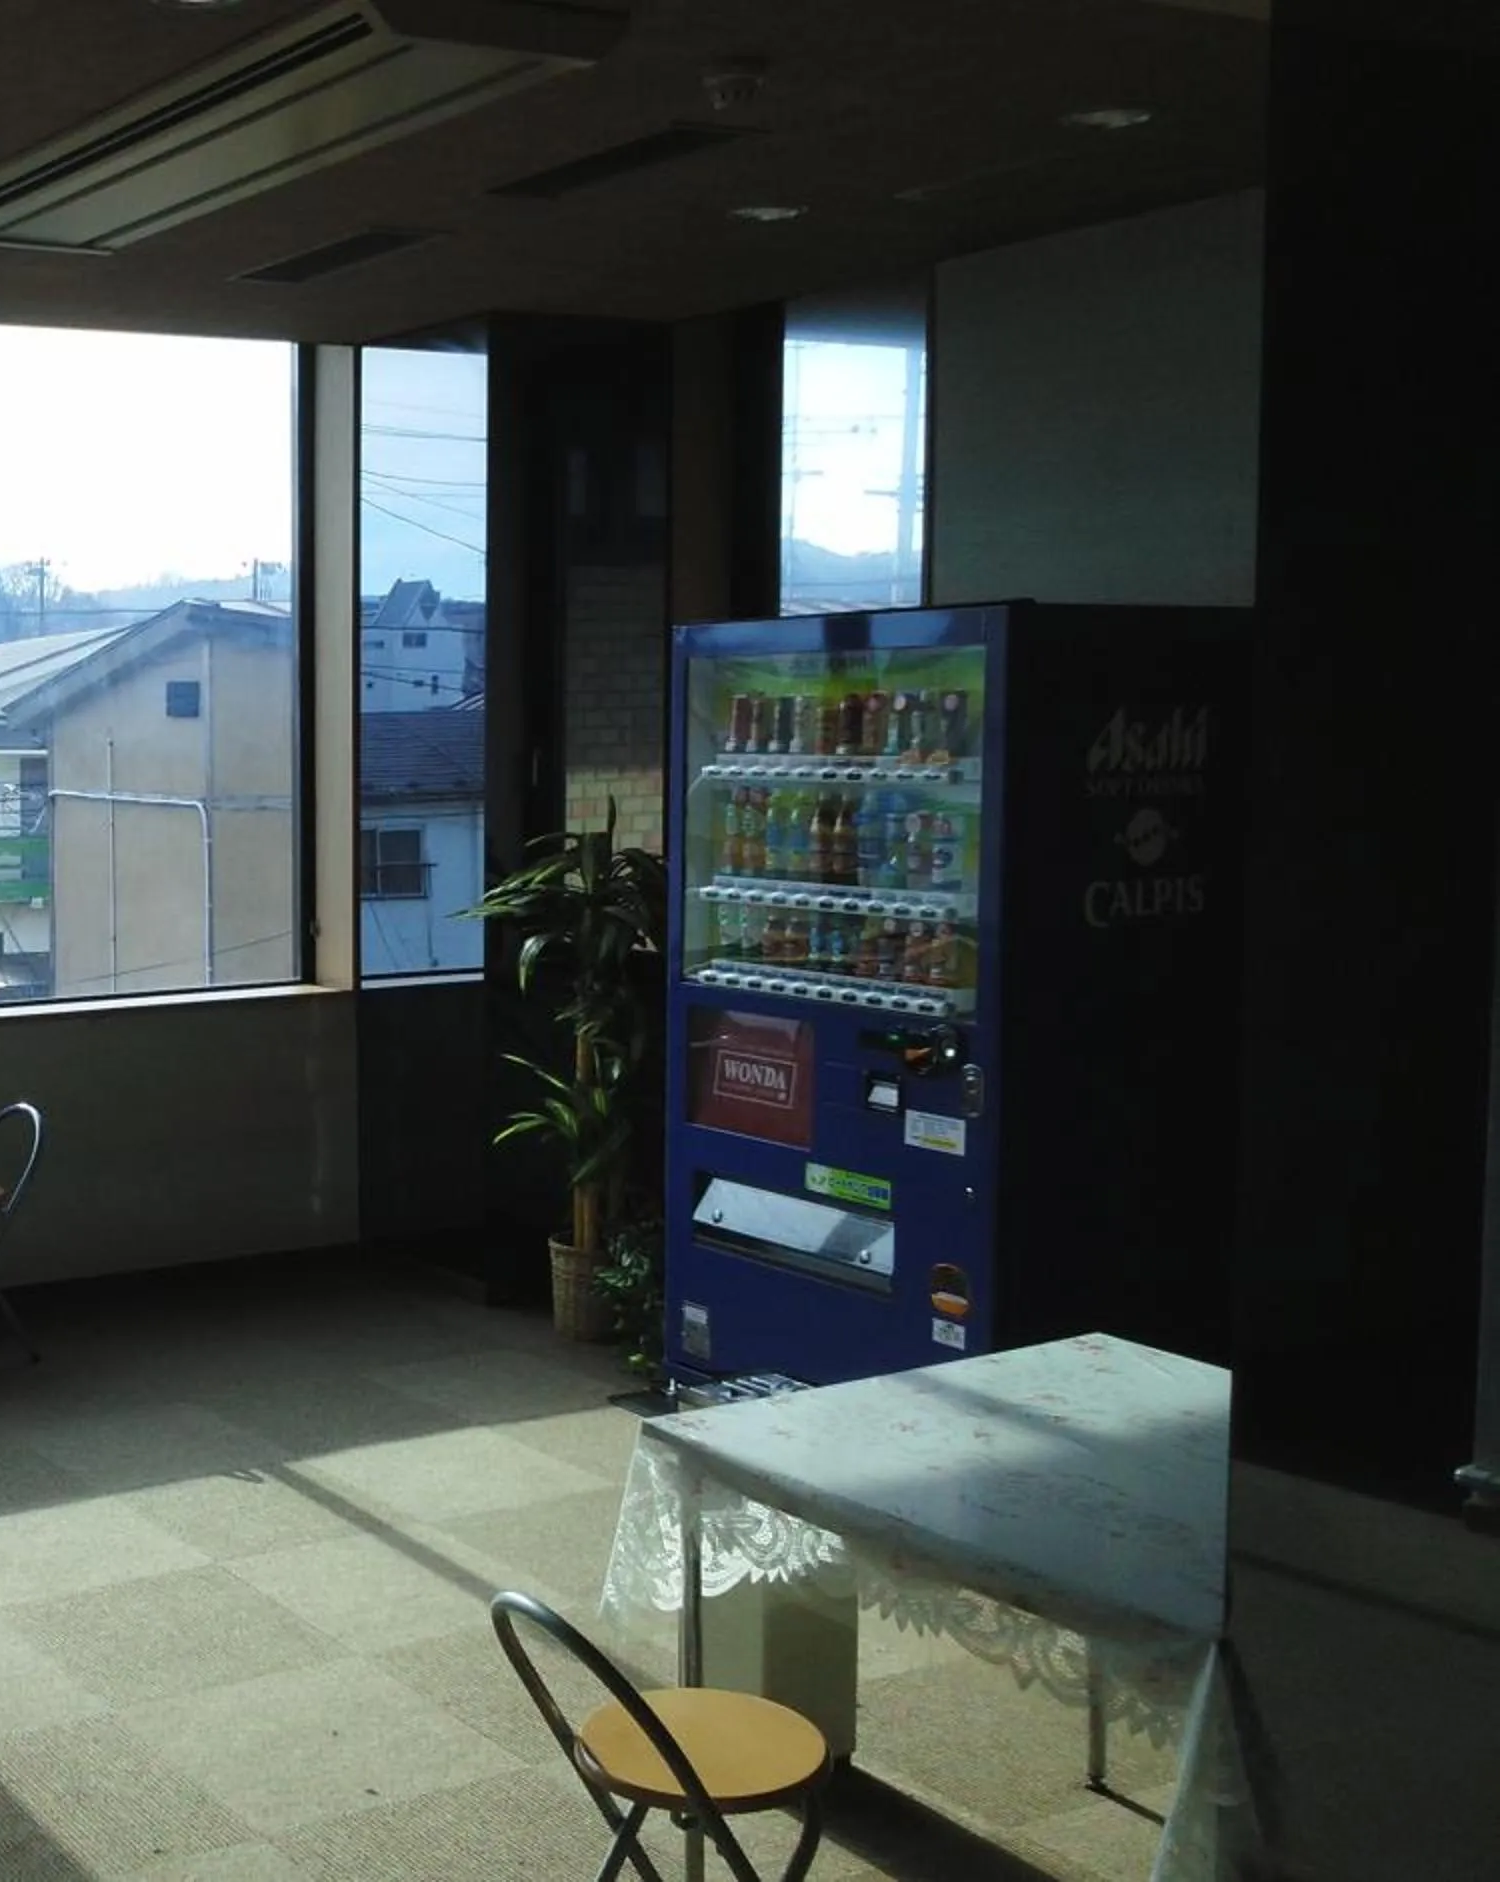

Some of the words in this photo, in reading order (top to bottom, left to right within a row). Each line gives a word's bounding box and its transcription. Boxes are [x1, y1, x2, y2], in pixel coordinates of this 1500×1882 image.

[1086, 703, 1210, 771] Asahi
[1083, 873, 1206, 928] CALPIS
[723, 1058, 788, 1090] WONDA
